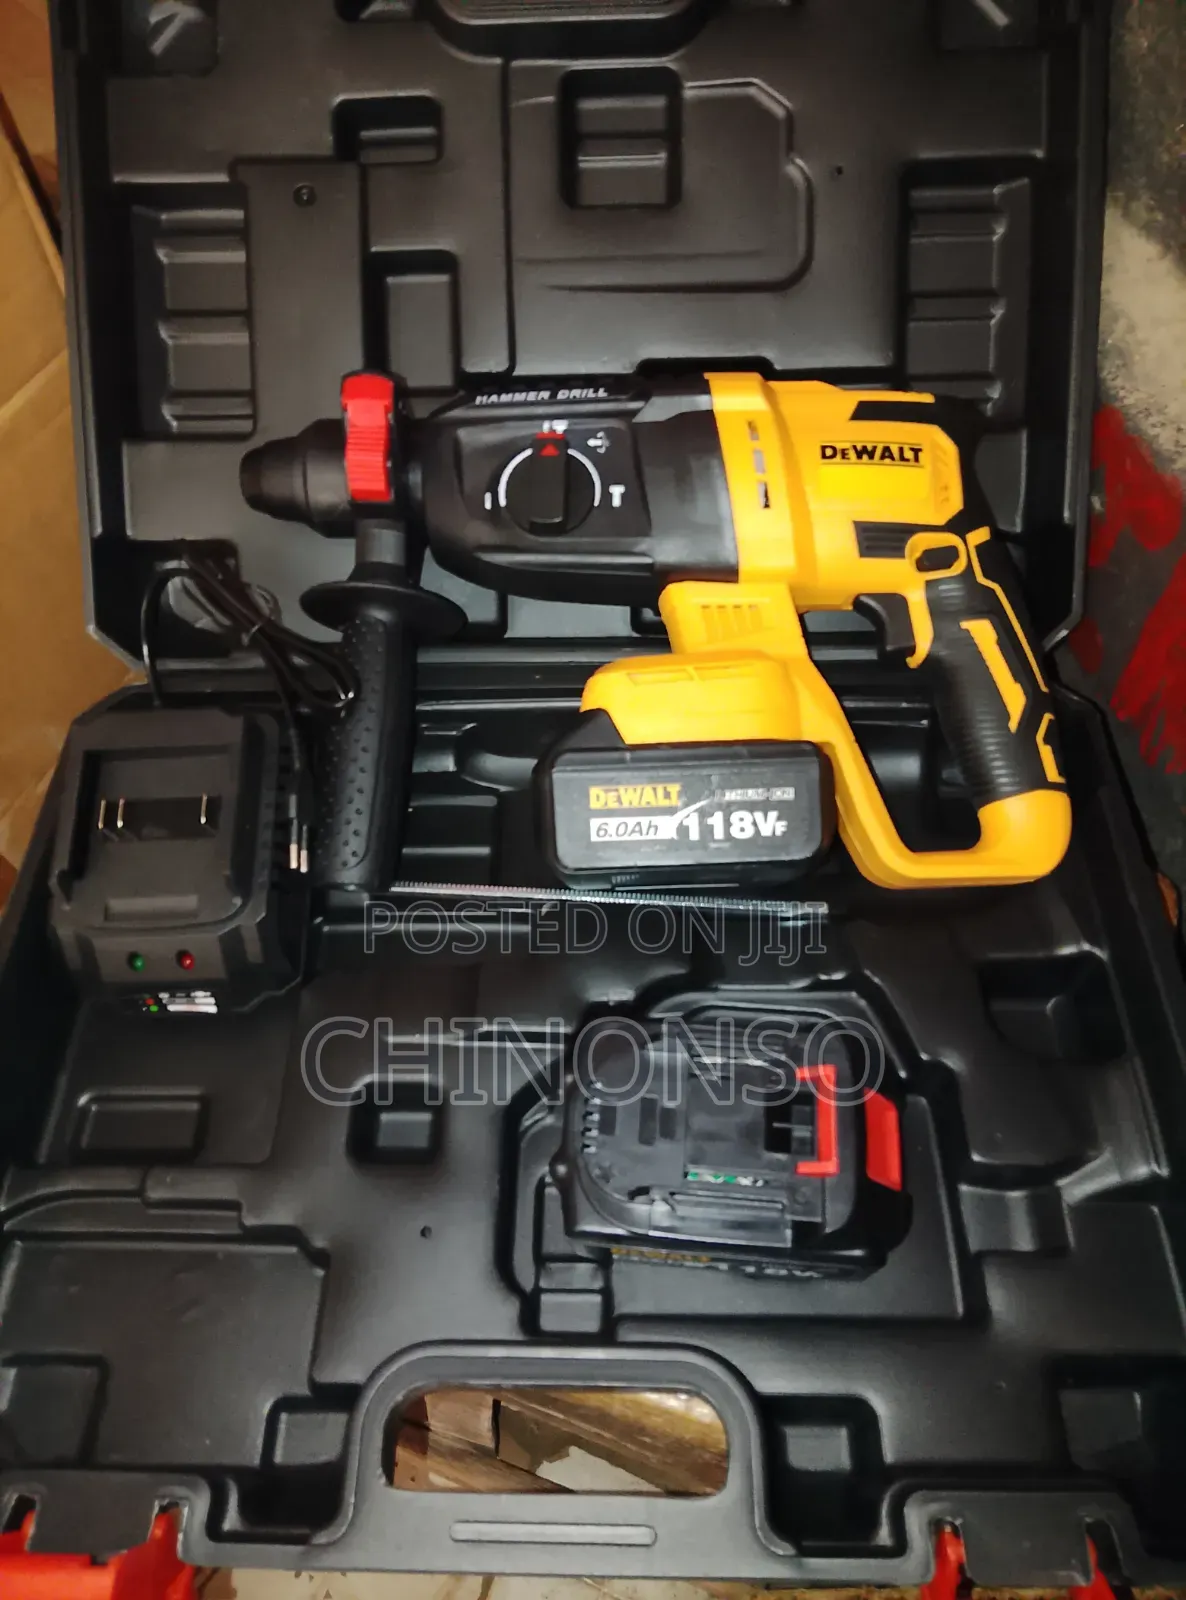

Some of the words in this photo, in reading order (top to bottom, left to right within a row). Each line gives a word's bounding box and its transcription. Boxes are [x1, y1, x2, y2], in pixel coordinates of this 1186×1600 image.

[475, 390, 551, 405] HAMMER
[556, 387, 608, 400] DRILL
[820, 444, 923, 464] DEWALT
[589, 784, 682, 809] DEWALT
[595, 820, 659, 839] 6.0Ah
